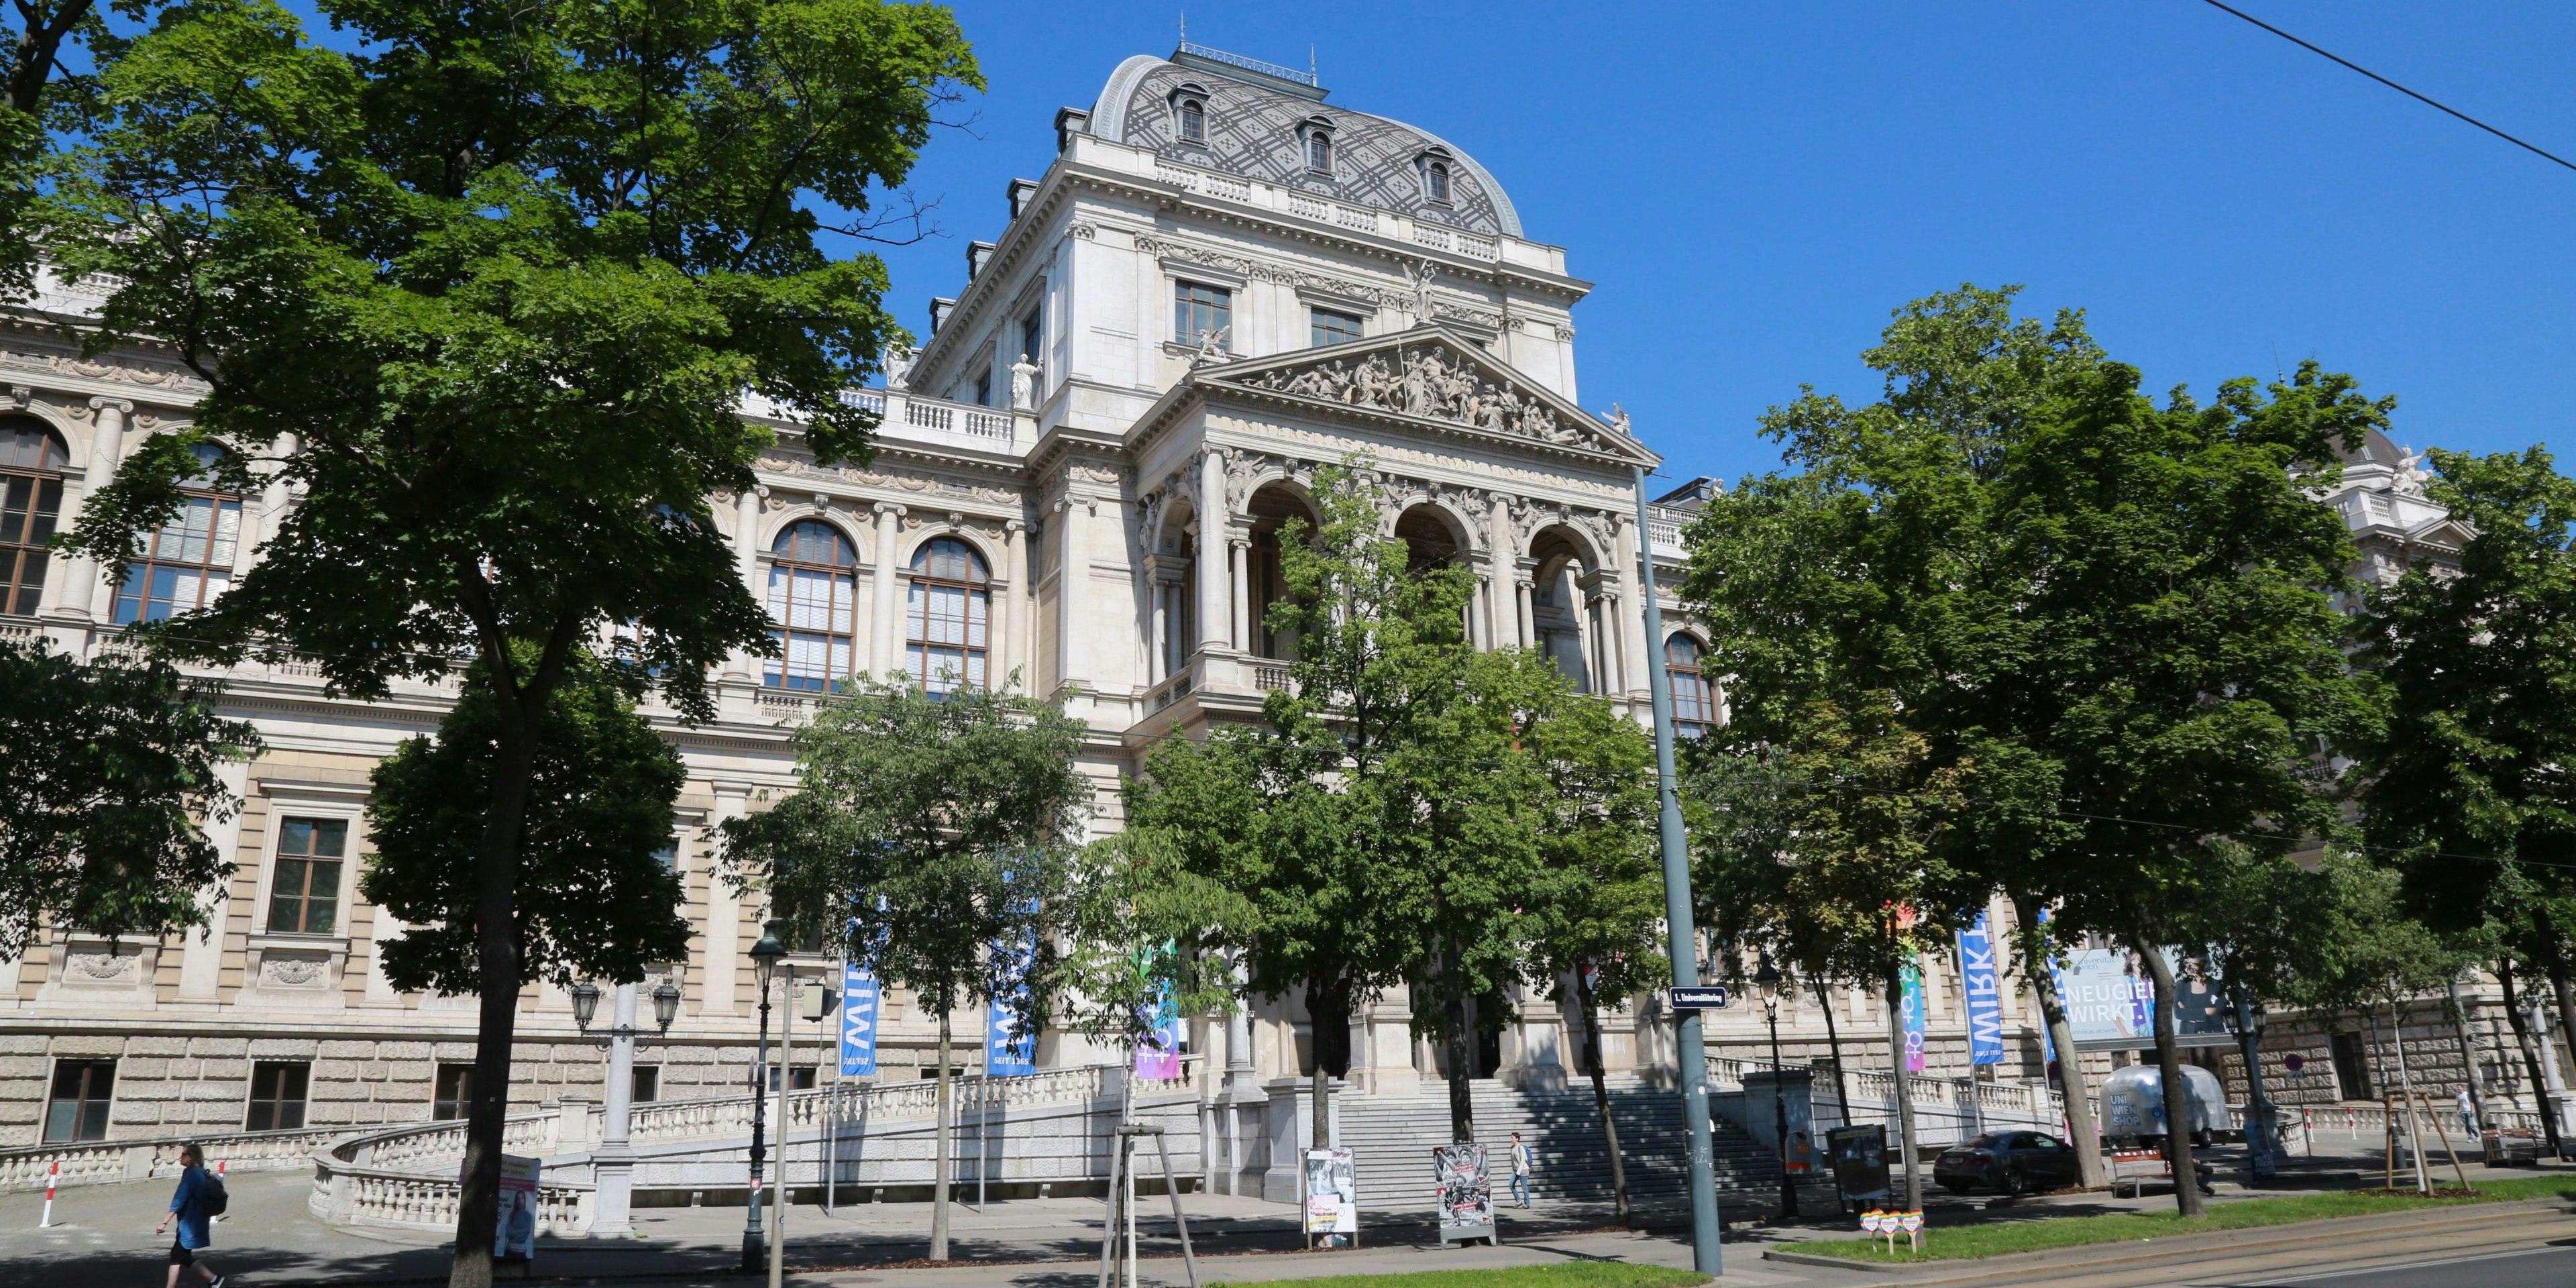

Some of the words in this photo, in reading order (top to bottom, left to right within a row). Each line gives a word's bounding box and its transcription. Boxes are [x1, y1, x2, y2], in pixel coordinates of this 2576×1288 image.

[1681, 993, 1722, 1004] Universitätsring
[2068, 1003, 2143, 1023] WIRKT.
[994, 1057, 1010, 1065] SEIT
[2110, 1095, 2127, 1104] UNI
[2112, 1106, 2137, 1115] WIEN
[2113, 1116, 2140, 1126] SHOP
